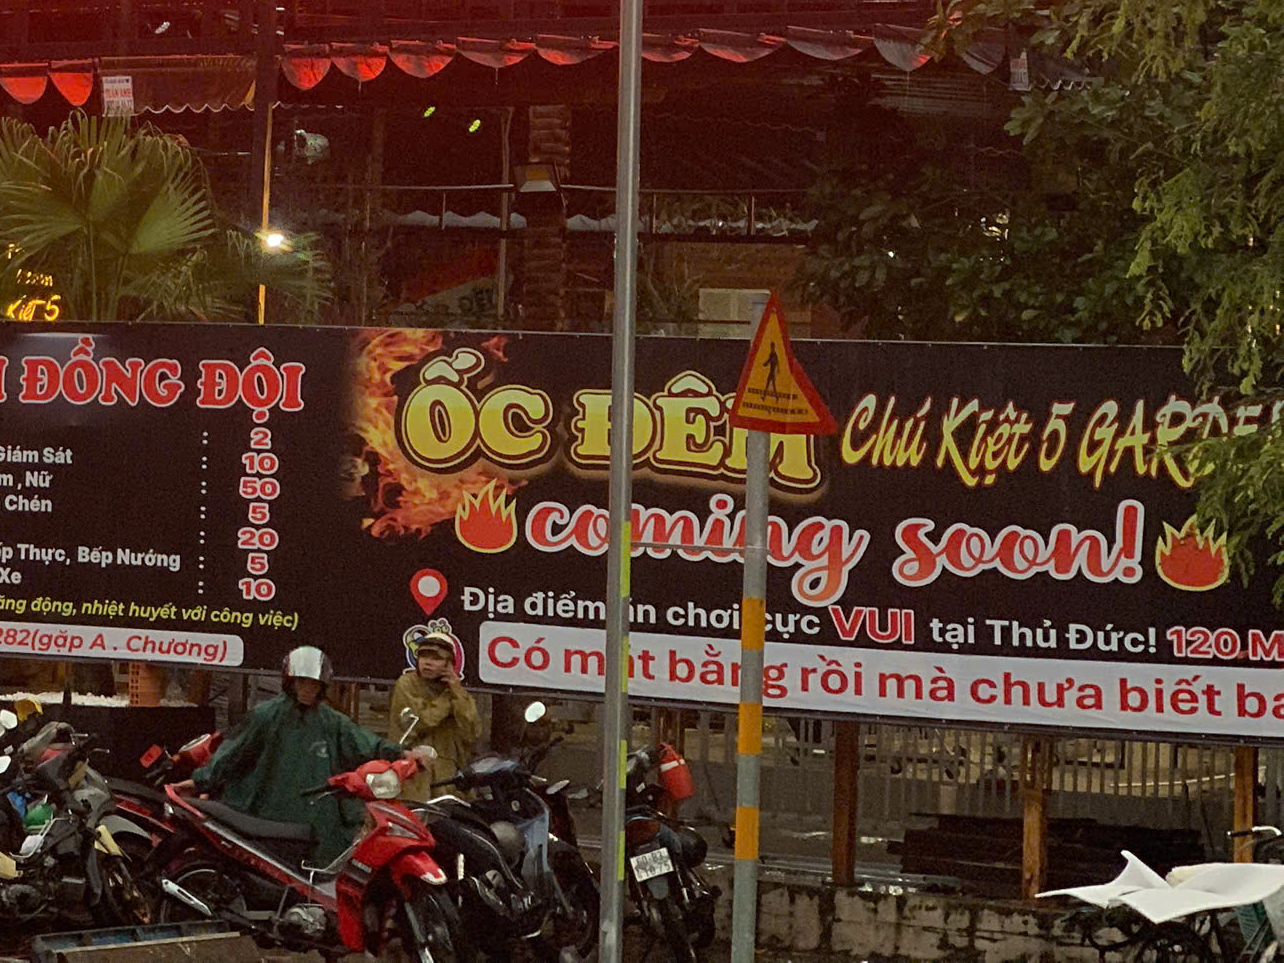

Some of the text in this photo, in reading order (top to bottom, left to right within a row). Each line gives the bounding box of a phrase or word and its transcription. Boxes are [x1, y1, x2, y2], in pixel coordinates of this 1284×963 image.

[19, 336, 185, 407] ĐỒNG
[197, 347, 305, 423] ĐỘI
[403, 349, 552, 466] ỐC
[841, 393, 927, 467] Chú
[936, 397, 1033, 487] Kiệt
[1039, 402, 1076, 472] 5
[1078, 394, 1284, 488] GARDE
[251, 428, 271, 448] 2
[43, 446, 73, 464] Sát
[242, 452, 278, 474] 10
[25, 470, 52, 488] Nữ
[240, 477, 280, 500] 50
[4, 494, 52, 512] Chén
[249, 502, 269, 524] 5
[238, 527, 278, 550] 20
[526, 494, 1145, 607] coming soon!
[17, 543, 70, 565] Thực,
[77, 546, 113, 568] Bếp
[116, 548, 181, 571] Nướng
[247, 553, 268, 574] 5
[239, 578, 275, 600] 10
[31, 597, 76, 616] động,
[81, 600, 124, 620] nhiệt
[129, 602, 177, 621] huyết
[182, 605, 208, 621] với
[210, 607, 253, 627] công
[258, 612, 299, 631] việc)
[461, 587, 514, 618] Địa
[523, 590, 606, 621] điểm
[666, 603, 740, 630] chơi
[828, 605, 915, 645] VUI
[930, 617, 975, 649] tại
[985, 619, 1057, 648] Thủ
[1065, 623, 1157, 653] Đức!
[1167, 625, 1241, 660] 120
[126, 635, 228, 663] Chương)
[487, 635, 551, 671] Có
[564, 648, 656, 681] mt
[800, 653, 863, 697] rồi
[878, 665, 955, 703] mà
[969, 671, 1103, 710] chưa
[1119, 674, 1222, 717] biết
